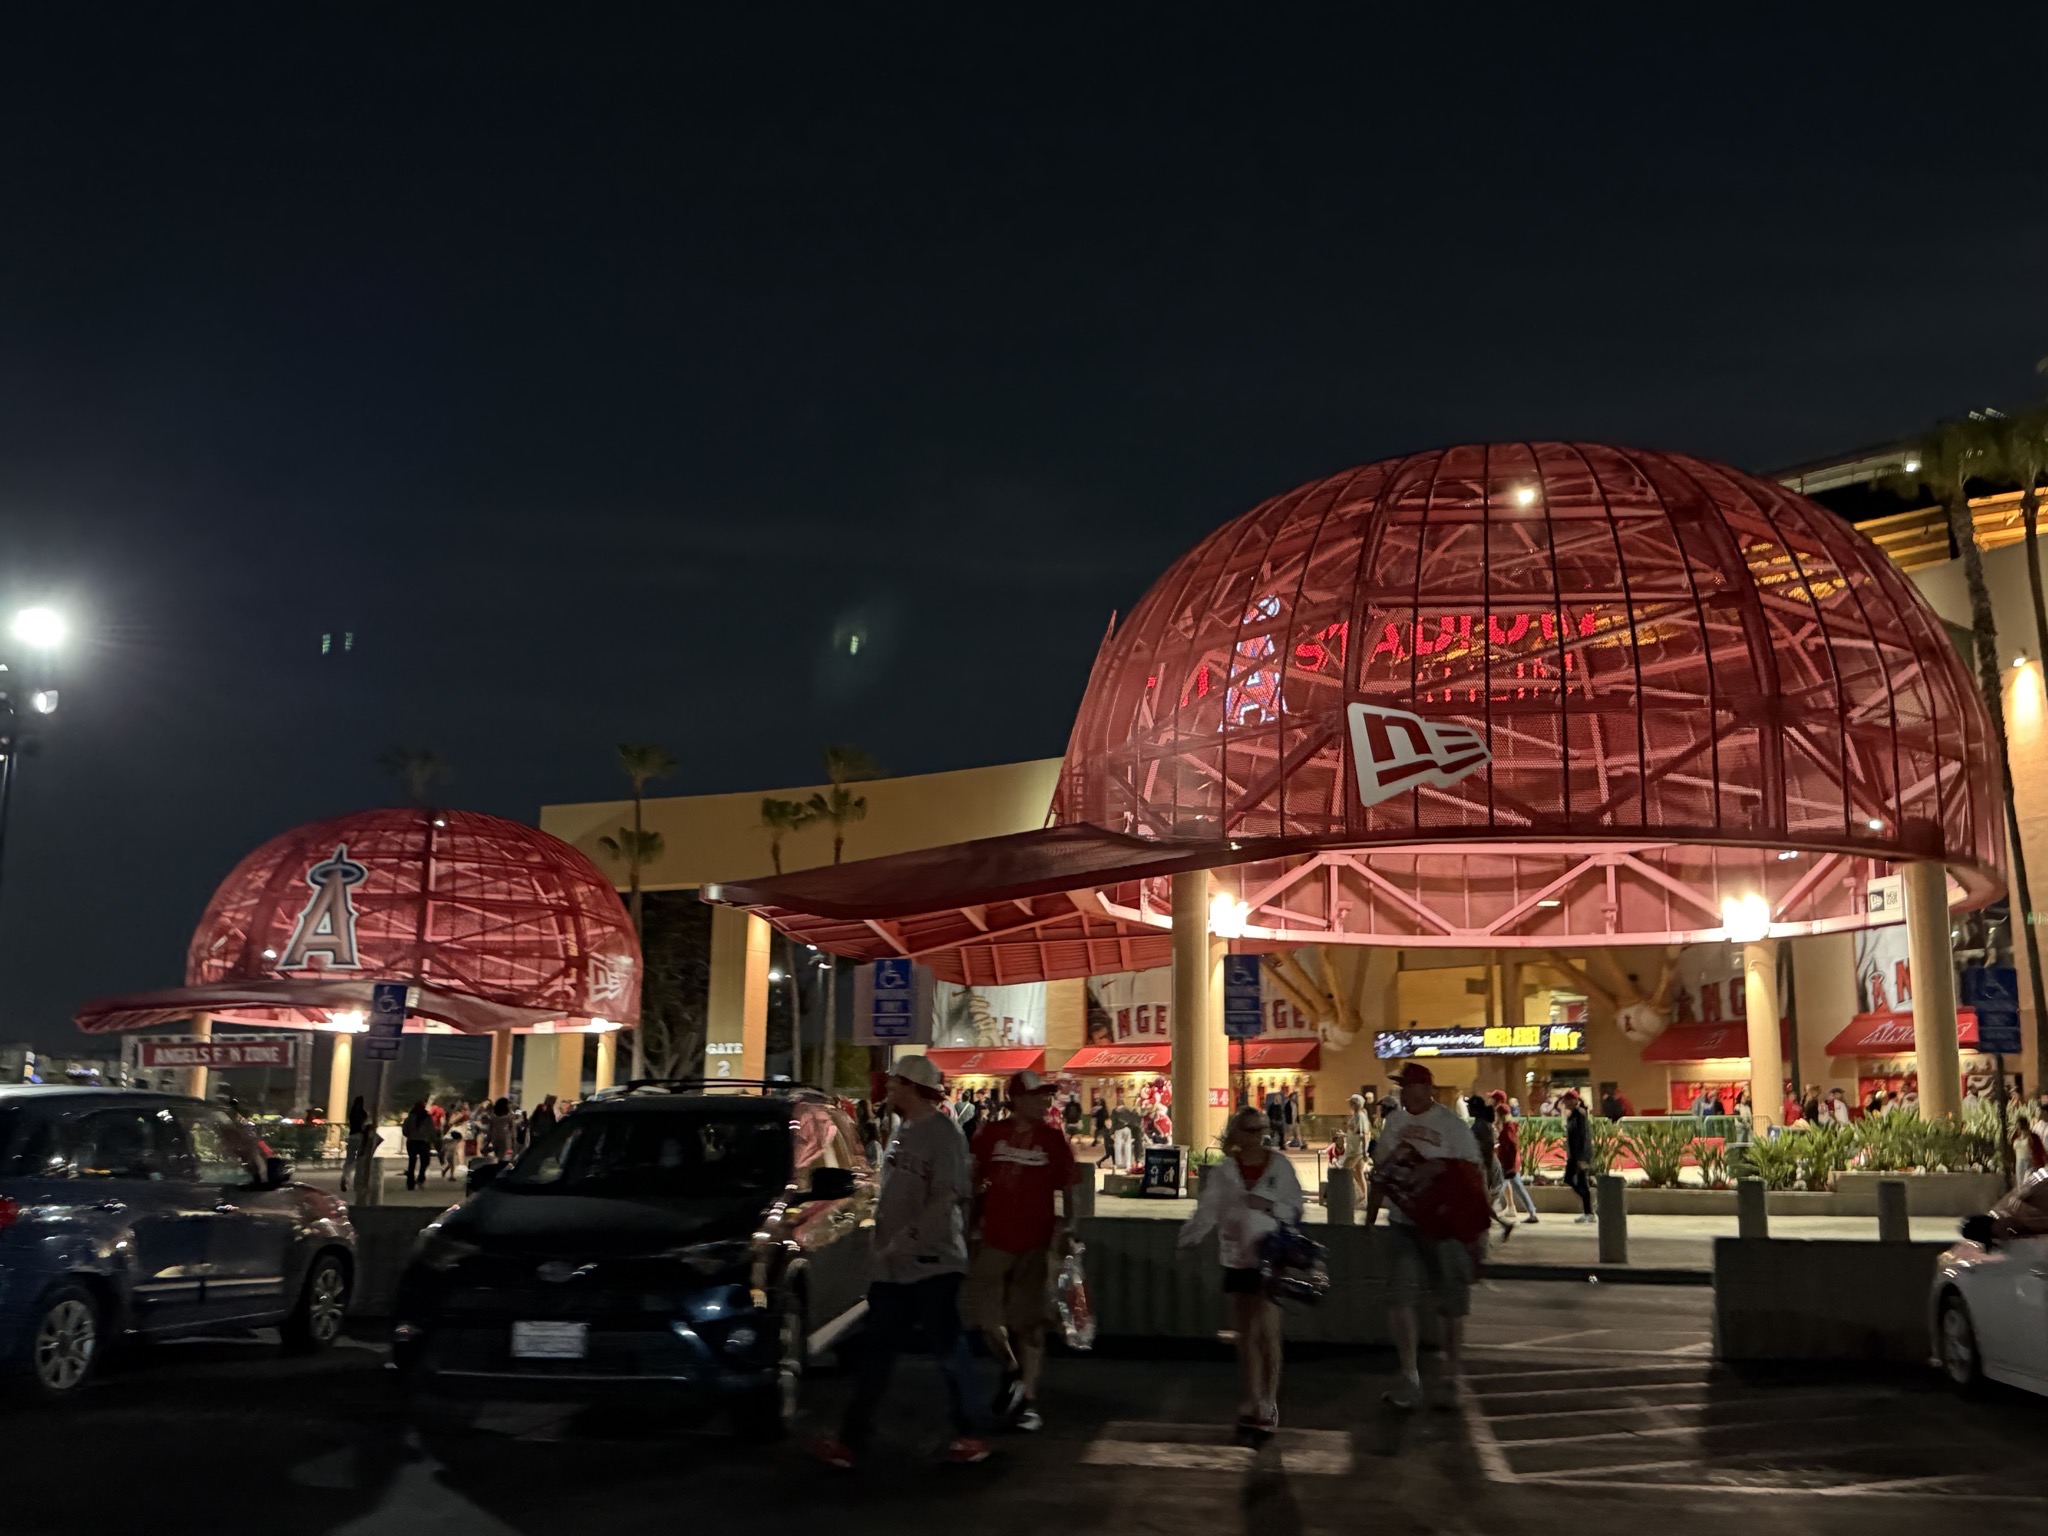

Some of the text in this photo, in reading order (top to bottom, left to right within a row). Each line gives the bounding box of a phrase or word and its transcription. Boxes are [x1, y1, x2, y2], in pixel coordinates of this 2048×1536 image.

[212, 1046, 241, 1063] FN
[705, 1043, 743, 1054] GATE
[1088, 1049, 1158, 1065] ANGELS
[717, 1060, 730, 1077] 2
